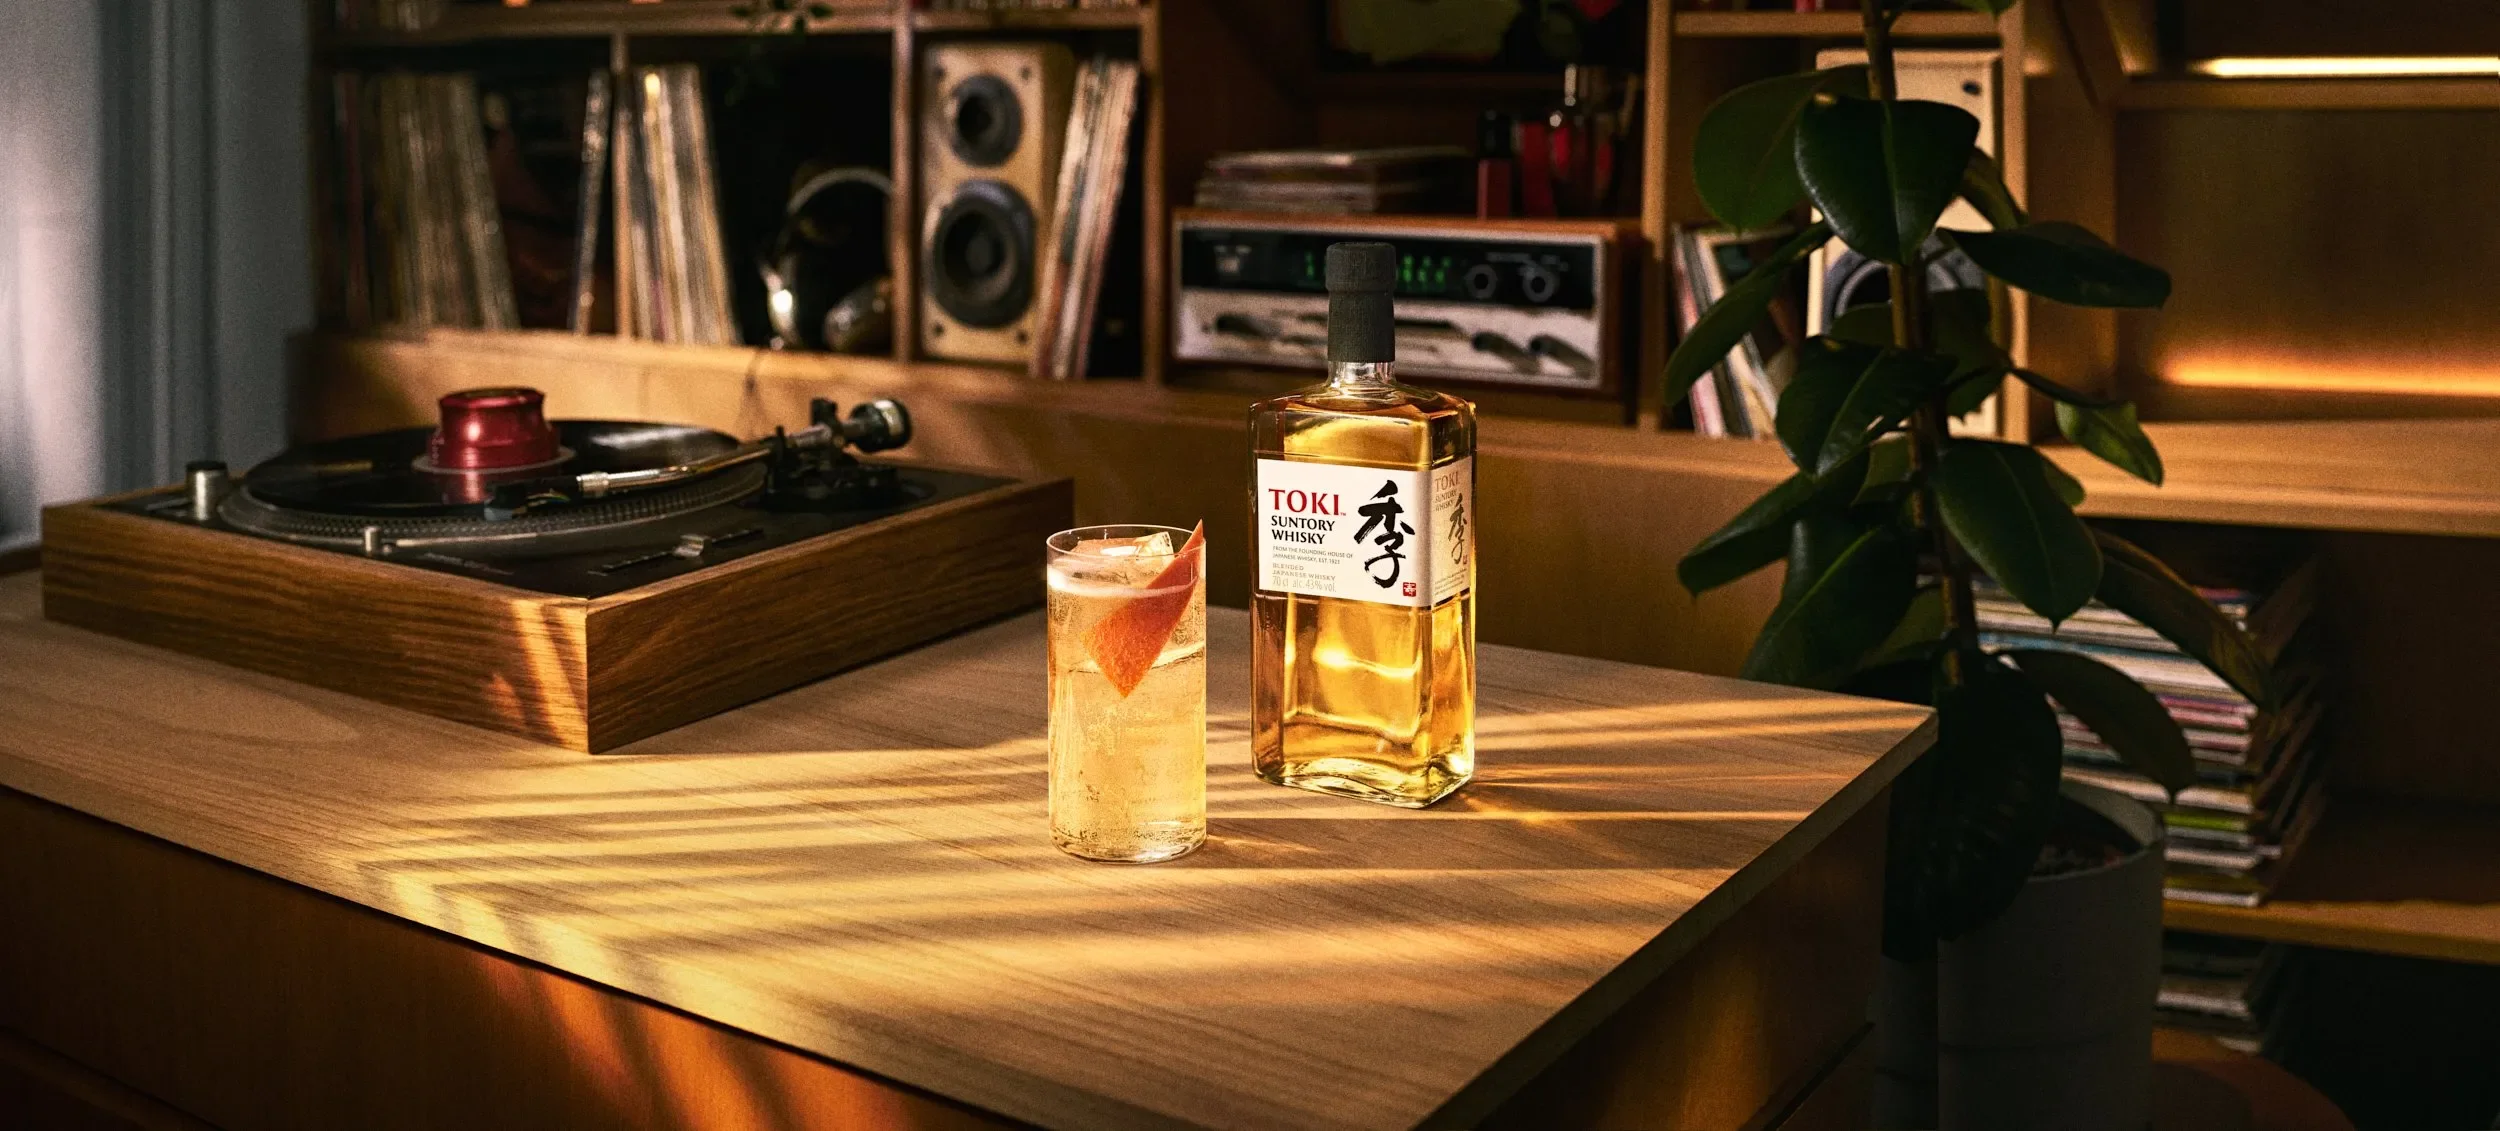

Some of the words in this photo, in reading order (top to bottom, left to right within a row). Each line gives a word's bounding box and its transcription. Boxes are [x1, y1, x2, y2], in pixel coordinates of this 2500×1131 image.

[1434, 470, 1460, 492] TOKI
[1271, 515, 1335, 531] SUNTORY
[1271, 529, 1326, 544] WHISKY
[1353, 479, 1416, 589] 季
[1298, 548, 1327, 556] FOUNDING
[1272, 562, 1305, 571] BLENDED
[1271, 569, 1306, 578] JAPANESE
[1307, 573, 1336, 581] WHISKY
